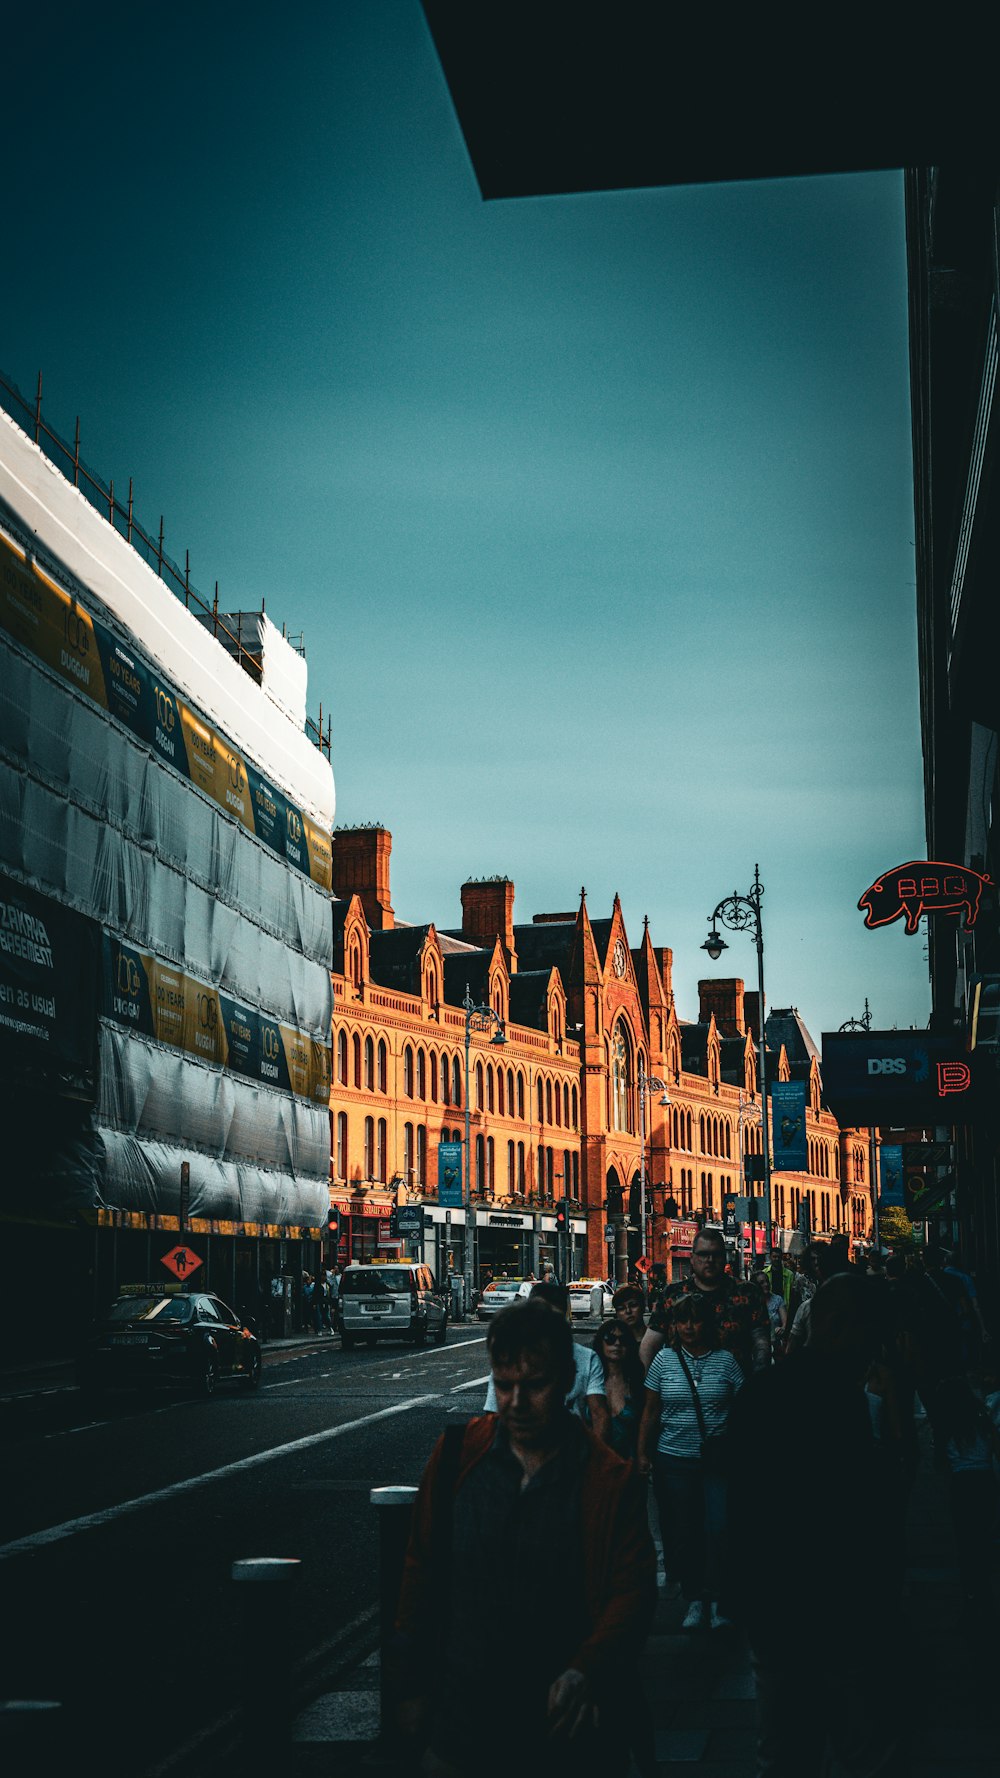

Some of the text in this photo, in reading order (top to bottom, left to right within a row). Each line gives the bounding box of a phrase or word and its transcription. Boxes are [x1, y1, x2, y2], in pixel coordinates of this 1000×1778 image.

[61, 649, 91, 685] DUGGAN
[120, 667, 141, 696] YEARS
[155, 726, 175, 757] DUGGAN
[898, 876, 967, 898] BBQ
[0, 902, 51, 946] ZAKAYA
[0, 928, 54, 968] BASEMENT
[0, 983, 56, 1019] en as usual
[167, 990, 185, 1009] YEARS
[867, 1058, 907, 1075] DBS
